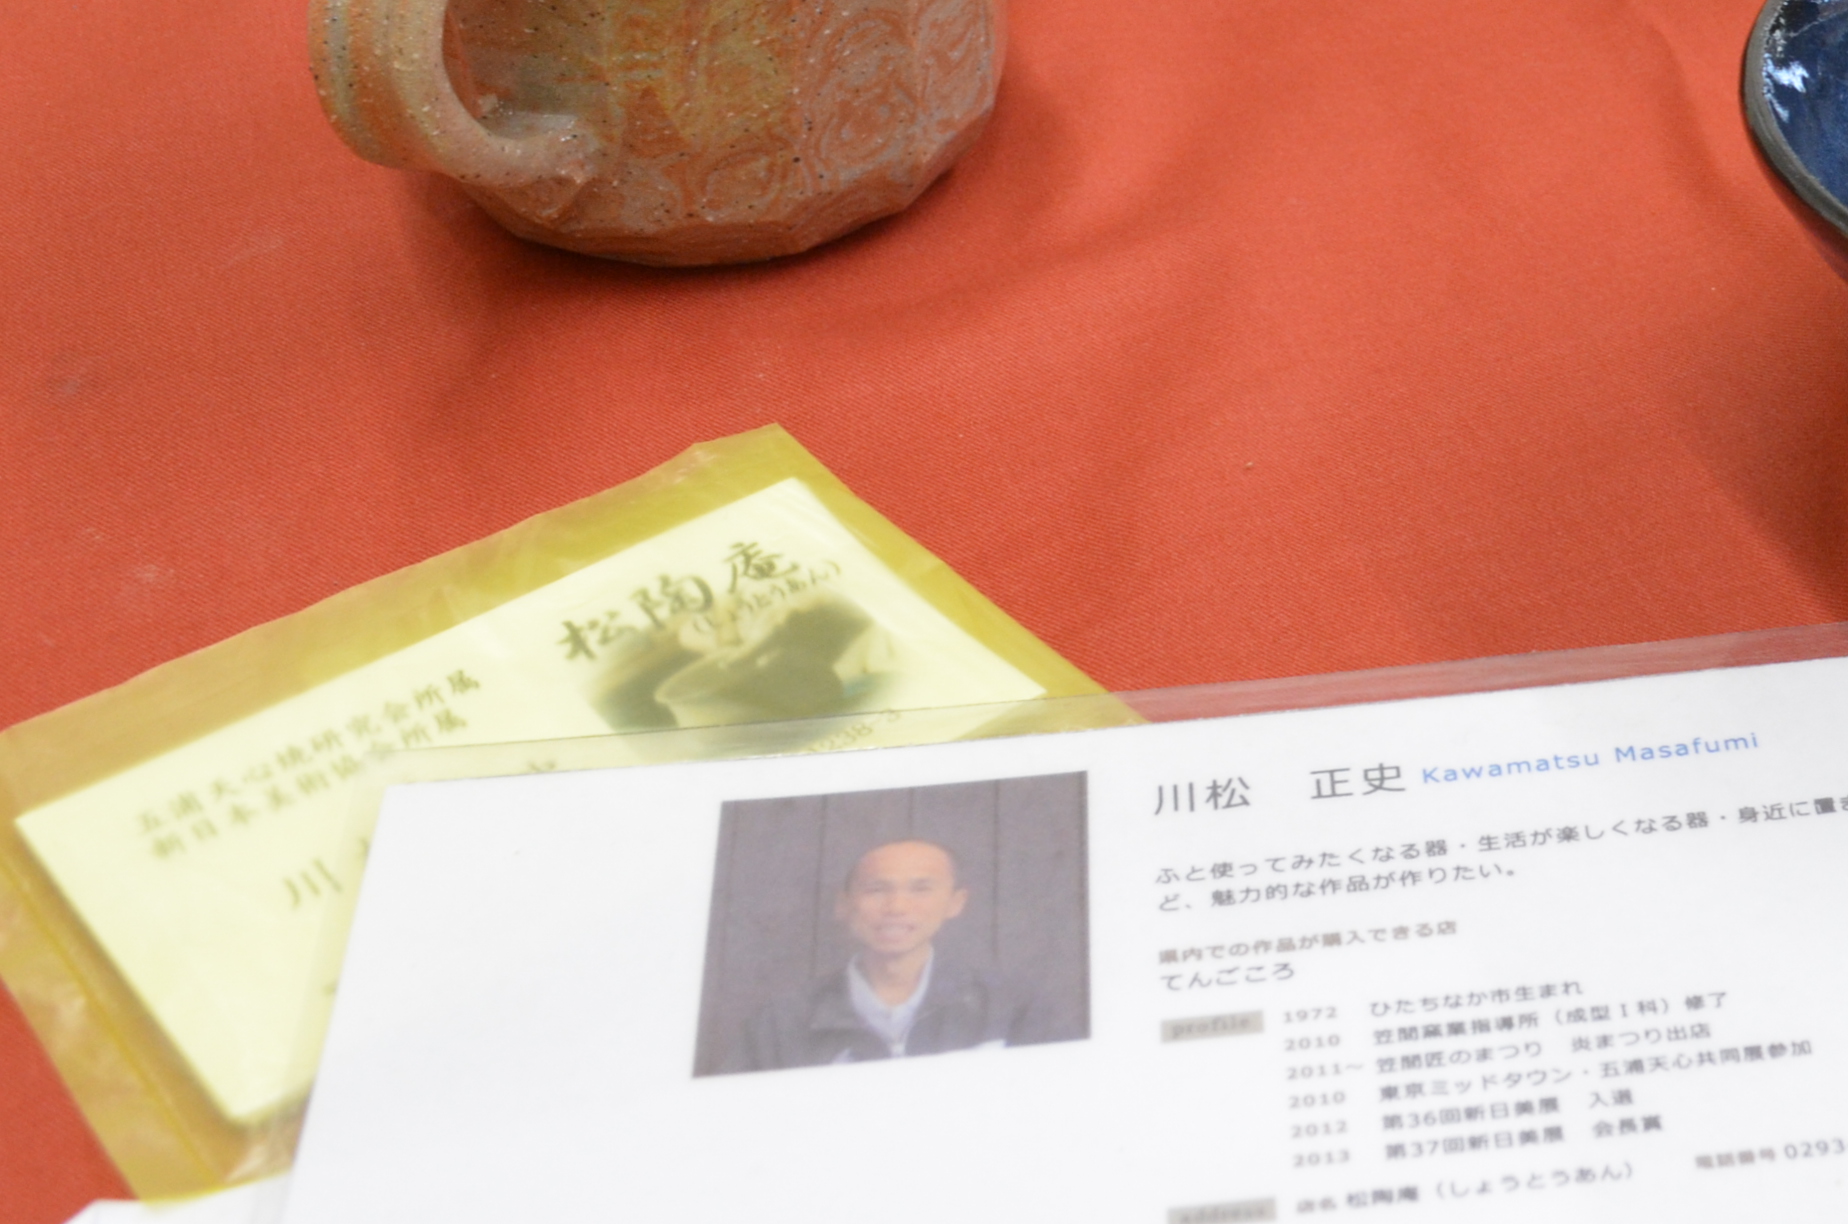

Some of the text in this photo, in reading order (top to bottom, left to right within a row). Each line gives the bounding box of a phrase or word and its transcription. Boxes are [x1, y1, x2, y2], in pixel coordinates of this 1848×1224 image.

[1153, 731, 1759, 815] 川松 正史 Kawamatsu Masafumi
[1158, 862, 1516, 912] ど、魅力的な作品が作りたい。
[1160, 962, 1295, 991] てんごころ
[1284, 980, 1584, 1024] 1972 ひたちなか市生まれ
[1284, 1034, 1341, 1052] 2010
[1376, 1041, 1543, 1075] 笠間匠のまつり
[1288, 1091, 1346, 1109] 2010
[1291, 1120, 1348, 1138] 2012
[1589, 1088, 1634, 1109] 入選
[1293, 1149, 1350, 1168] 2013
